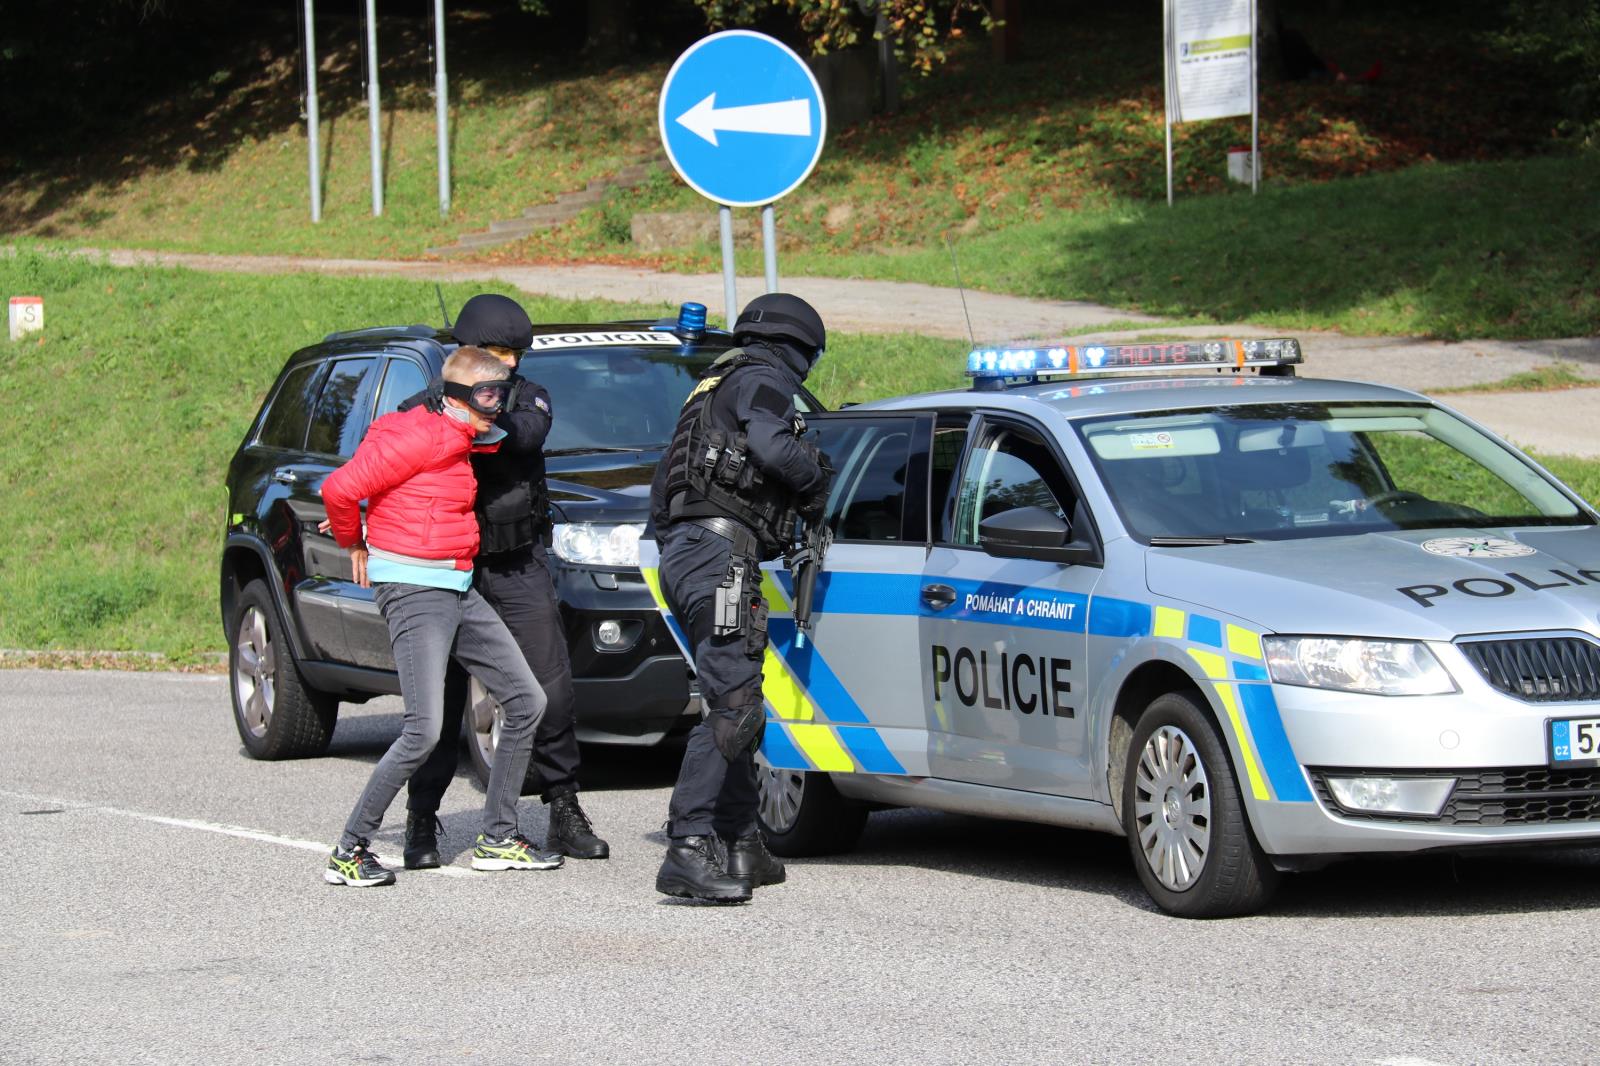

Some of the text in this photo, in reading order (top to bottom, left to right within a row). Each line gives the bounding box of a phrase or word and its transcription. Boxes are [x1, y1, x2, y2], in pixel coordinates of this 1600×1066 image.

[536, 333, 671, 346] POLICIE
[965, 592, 1076, 620] POMÁHAT A CHRÁNIT
[931, 644, 1075, 719] POLICIE
[1555, 745, 1569, 756] CZ
[1577, 723, 1600, 754] 5
